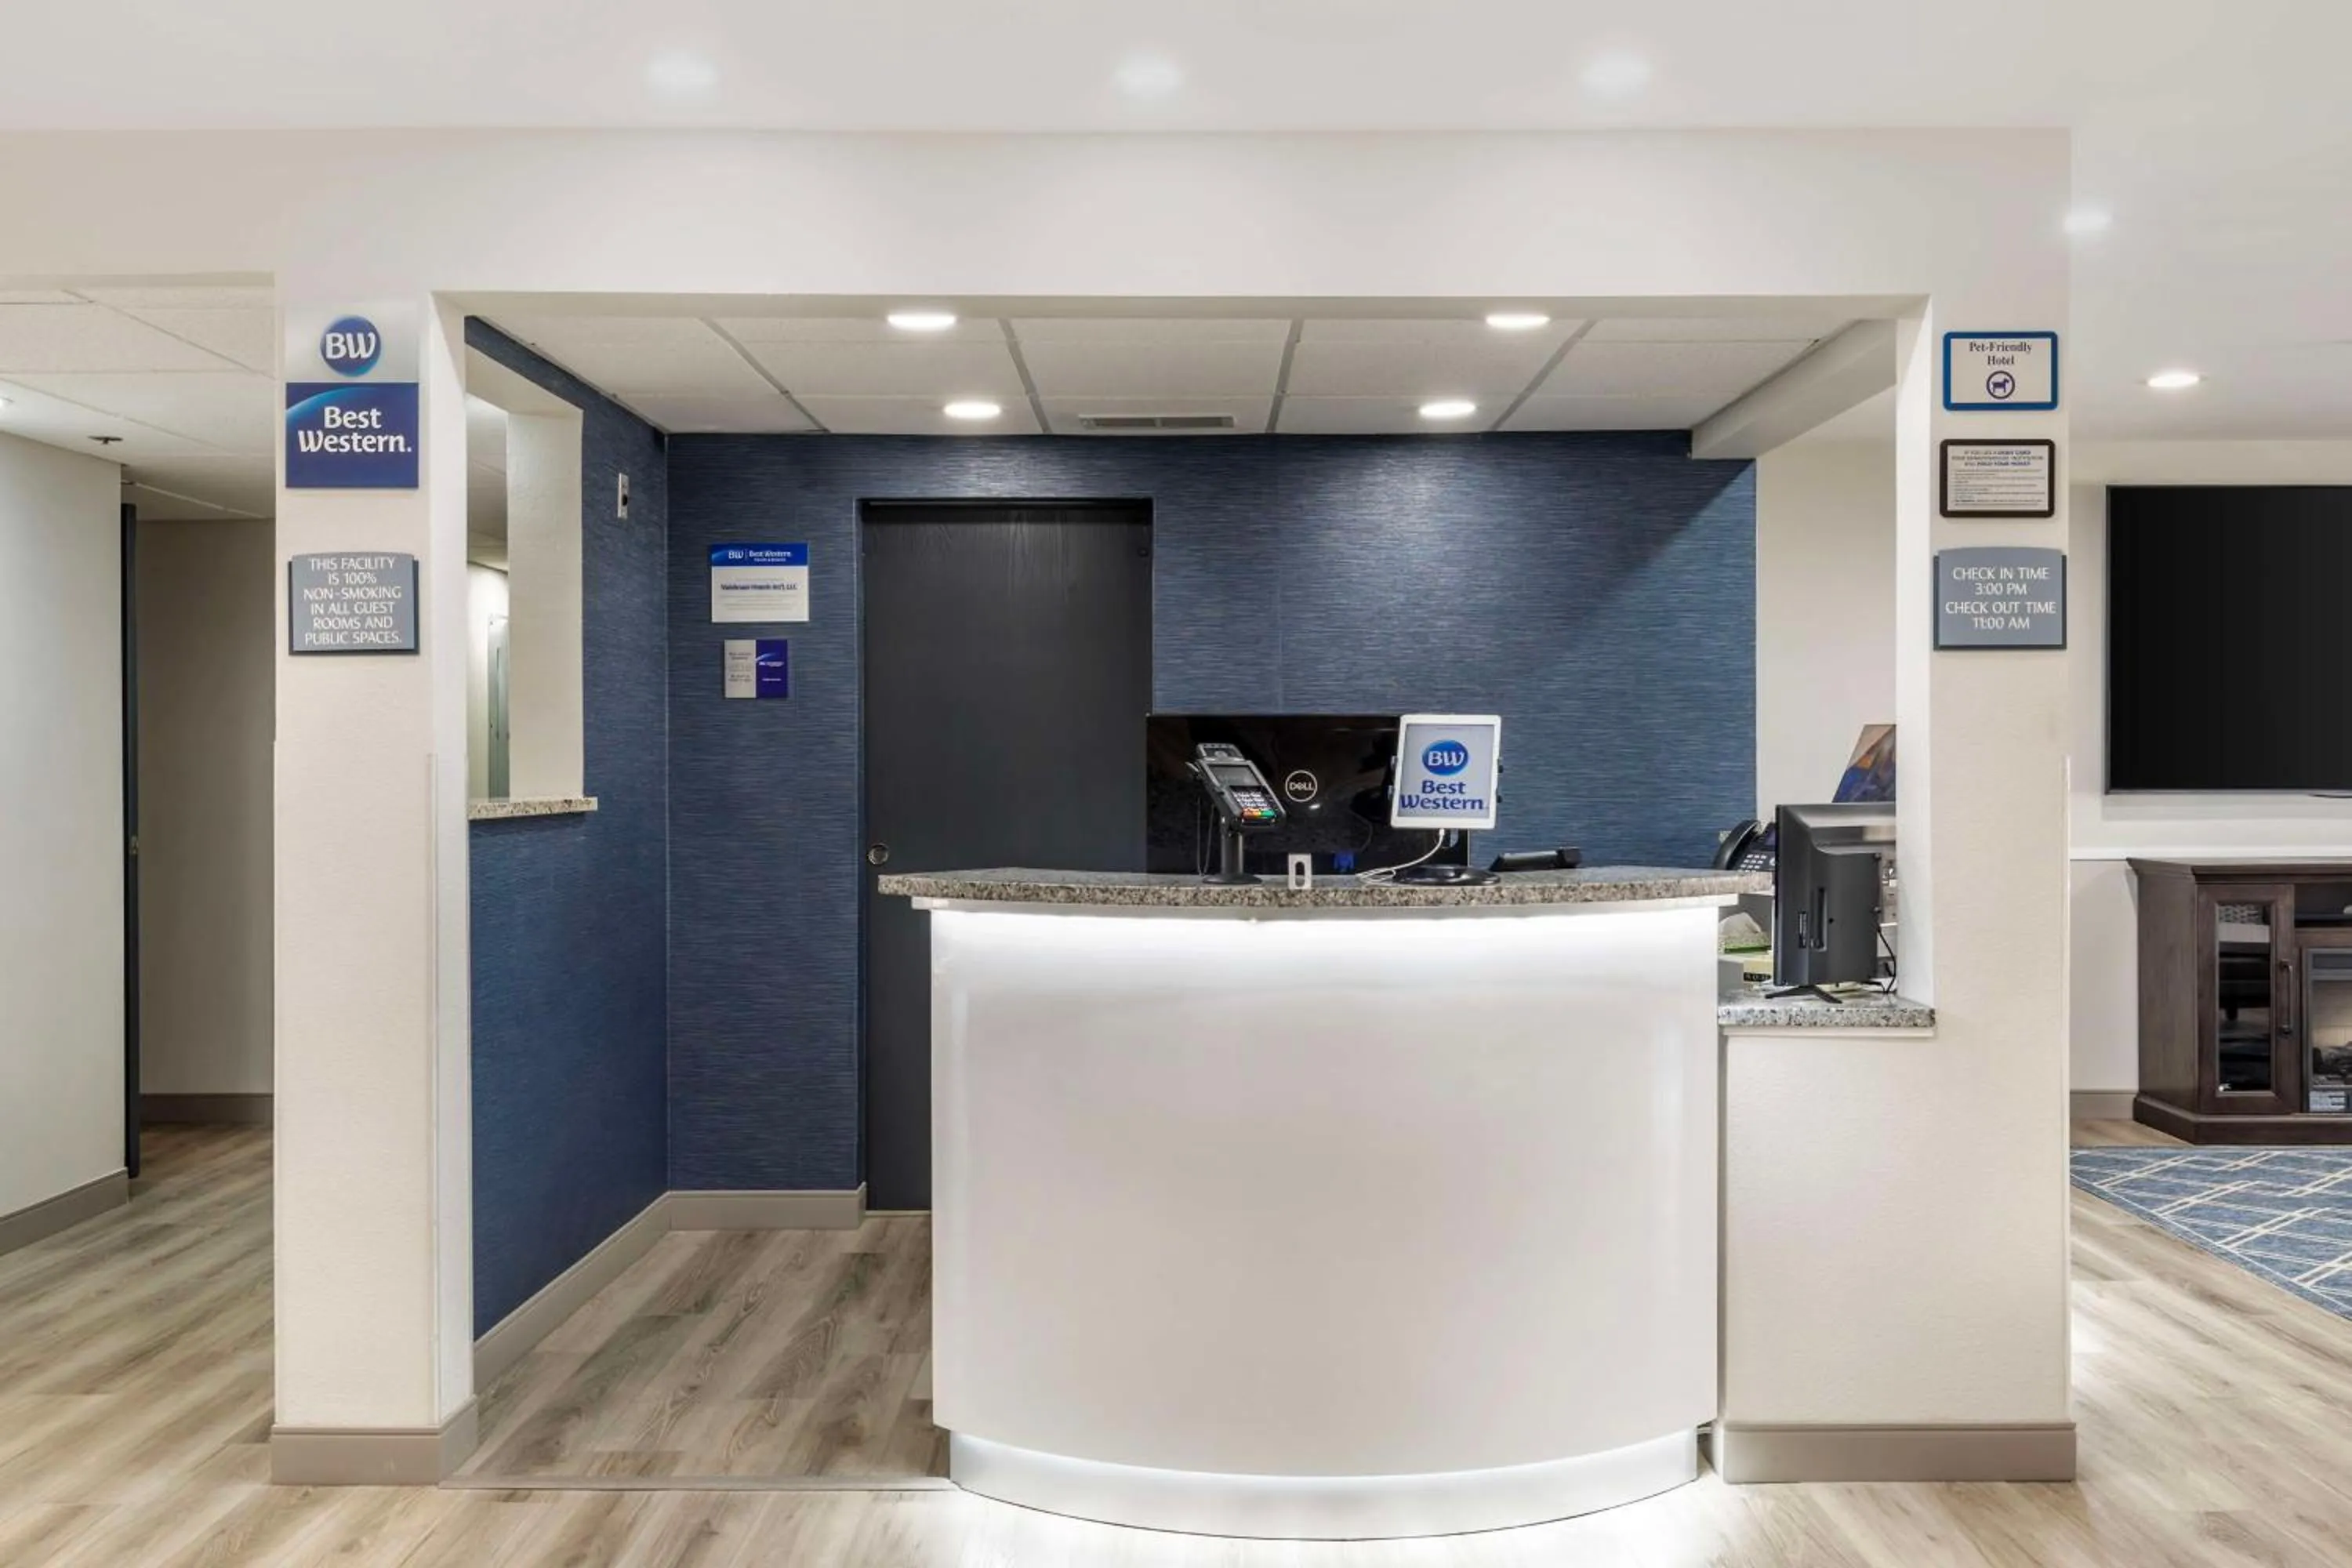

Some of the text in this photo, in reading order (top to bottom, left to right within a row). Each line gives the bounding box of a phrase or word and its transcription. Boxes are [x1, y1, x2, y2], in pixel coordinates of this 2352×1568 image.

[325, 332, 376, 359] BW
[1969, 341, 2031, 354] Pet-Friendly
[1987, 355, 2014, 365] Hotel
[324, 405, 382, 429] Best
[309, 557, 395, 571] THIS FACILITY
[328, 572, 377, 585] IS 100%
[1953, 567, 2050, 580] CHECK IN TIME
[303, 586, 401, 601] NON-SMOKING
[1975, 583, 2027, 595] 3:00 PM
[310, 601, 395, 615] IN ALL GUEST
[1945, 601, 2057, 614] CHECK OUT TIME
[313, 616, 393, 630] ROOMS AND
[1973, 616, 2030, 630] 11:00 AM
[305, 630, 402, 645] PUBLIC SPACES.
[1428, 750, 1465, 767] BW
[1289, 782, 1315, 791] DELL
[1421, 780, 1466, 794] Best
